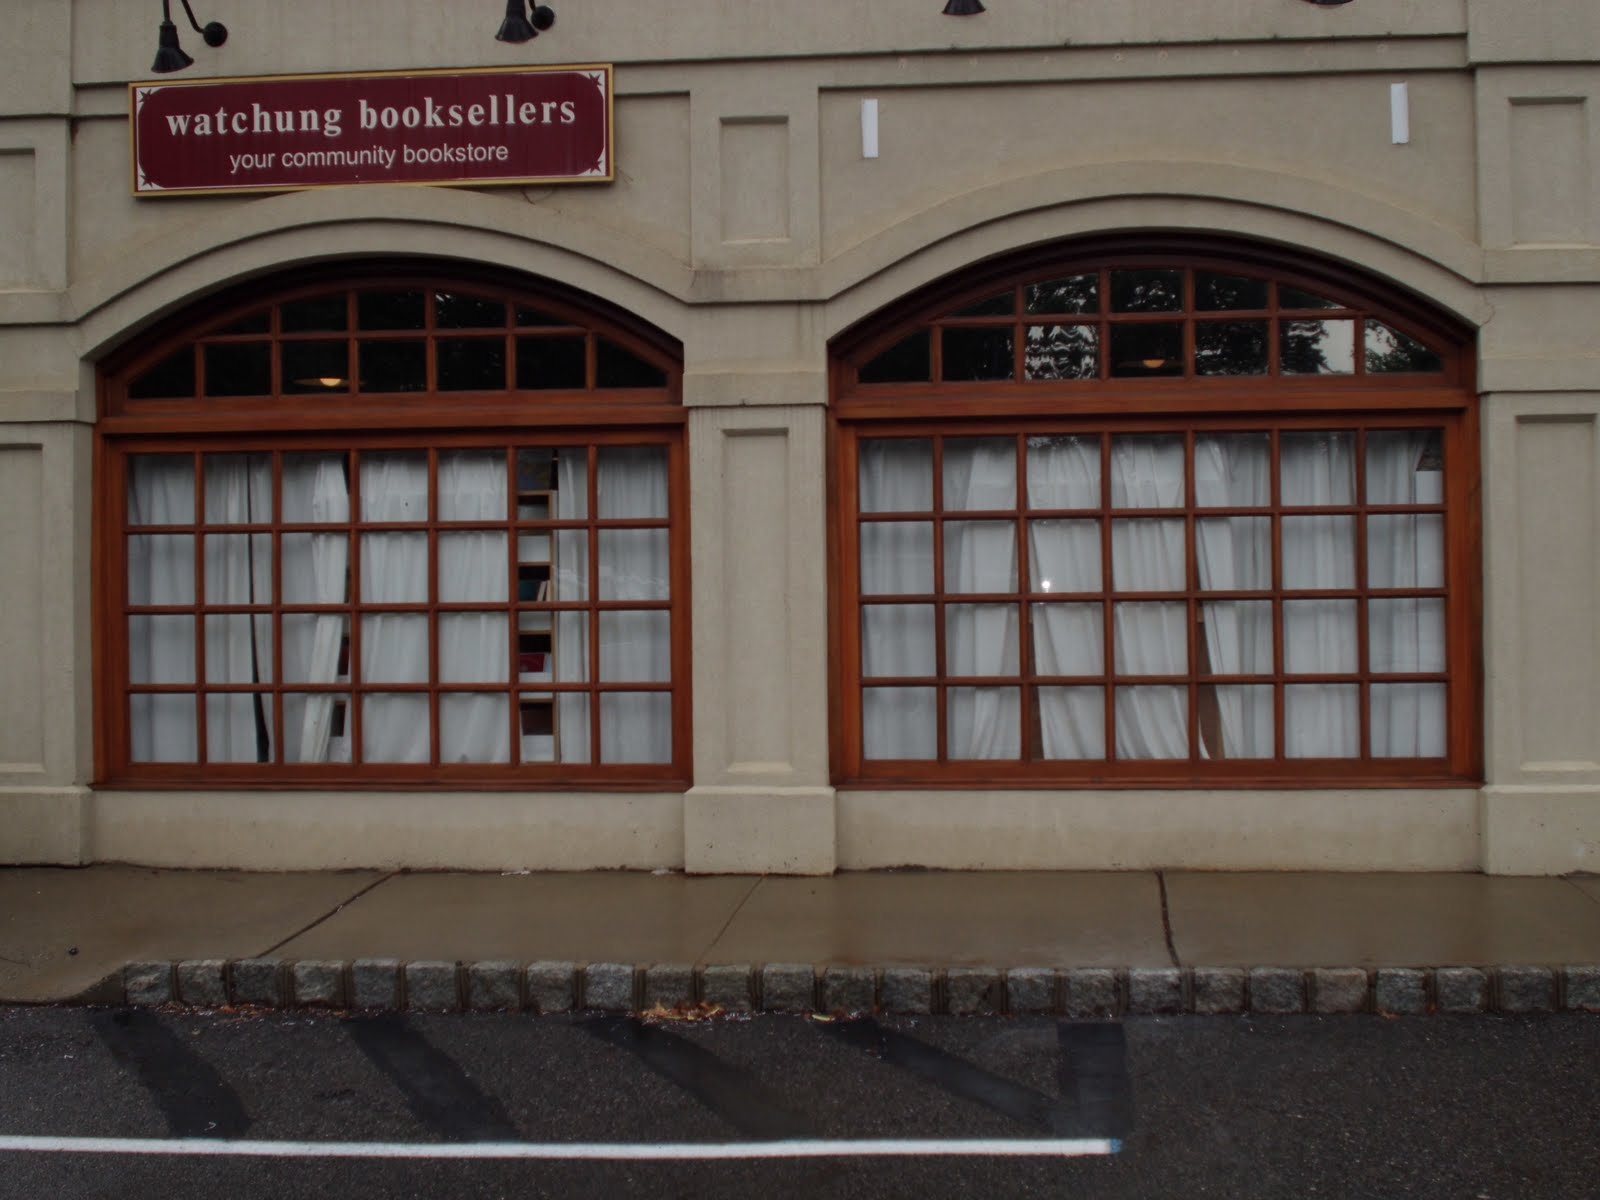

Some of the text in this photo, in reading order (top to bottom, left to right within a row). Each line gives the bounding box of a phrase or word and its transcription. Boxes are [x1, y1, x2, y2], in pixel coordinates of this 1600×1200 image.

[165, 94, 576, 137] watchung booksellers
[229, 143, 509, 174] your community bookstore
